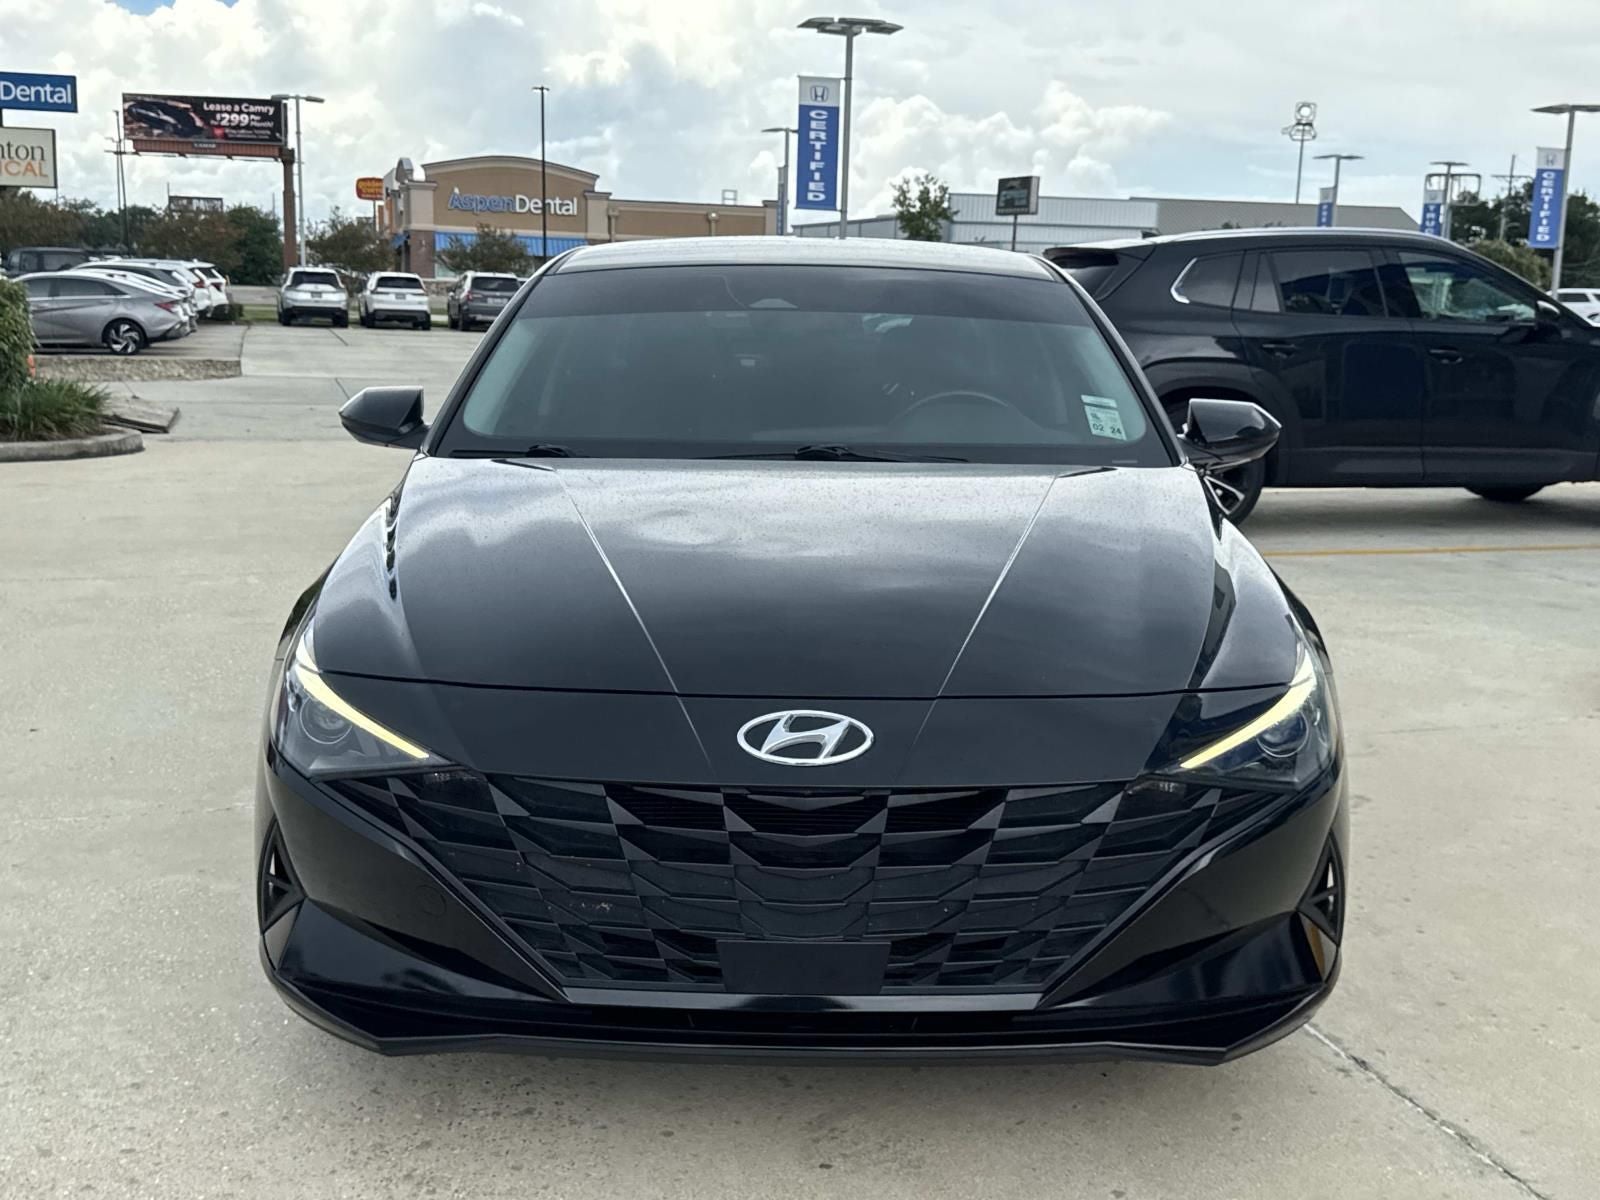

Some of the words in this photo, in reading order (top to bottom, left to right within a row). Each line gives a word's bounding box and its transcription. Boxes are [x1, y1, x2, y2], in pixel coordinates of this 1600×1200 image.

[0, 81, 71, 104] Dental
[203, 102, 232, 112] Lease
[233, 104, 240, 112] a
[241, 103, 275, 115] Camry
[807, 109, 829, 201] CERTIFIED
[1536, 171, 1555, 241] CERTIFIED
[1110, 426, 1121, 434] 24
